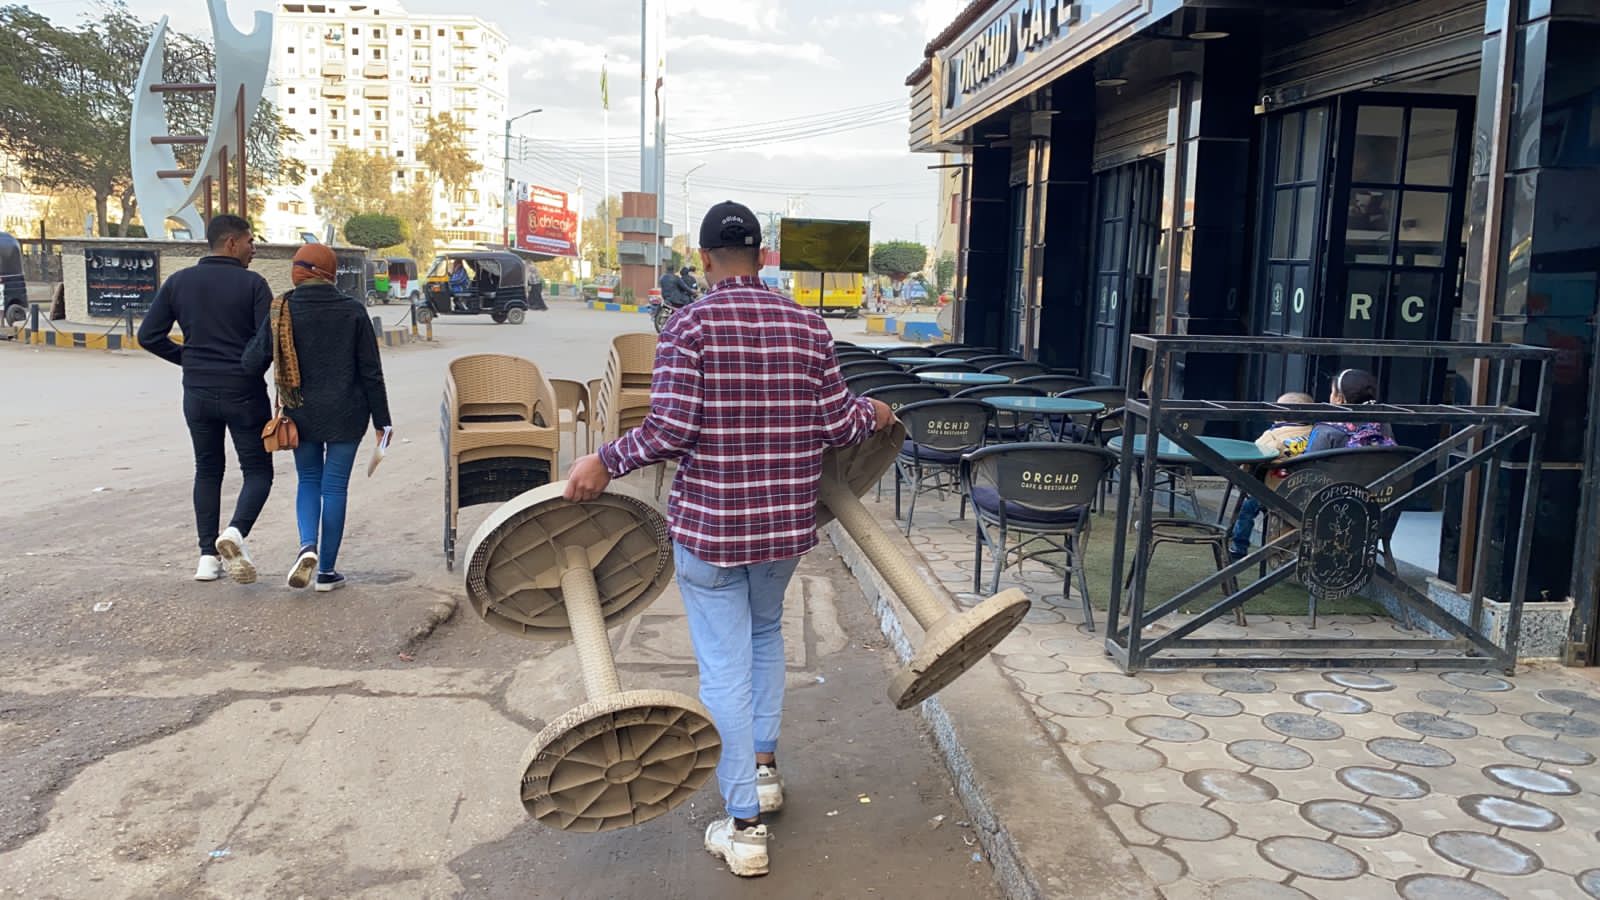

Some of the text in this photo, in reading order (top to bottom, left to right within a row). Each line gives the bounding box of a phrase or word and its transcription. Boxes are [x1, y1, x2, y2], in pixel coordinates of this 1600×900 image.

[960, 11, 1012, 94] ORCHID
[721, 215, 744, 225] adidas
[1294, 287, 1425, 323] O R C
[928, 420, 970, 430] ORCHID
[1022, 471, 1079, 484] ORCHID
[1021, 482, 1036, 490] CAFE
[1320, 485, 1370, 503] ORCHID
[1366, 519, 1379, 568] 2020
